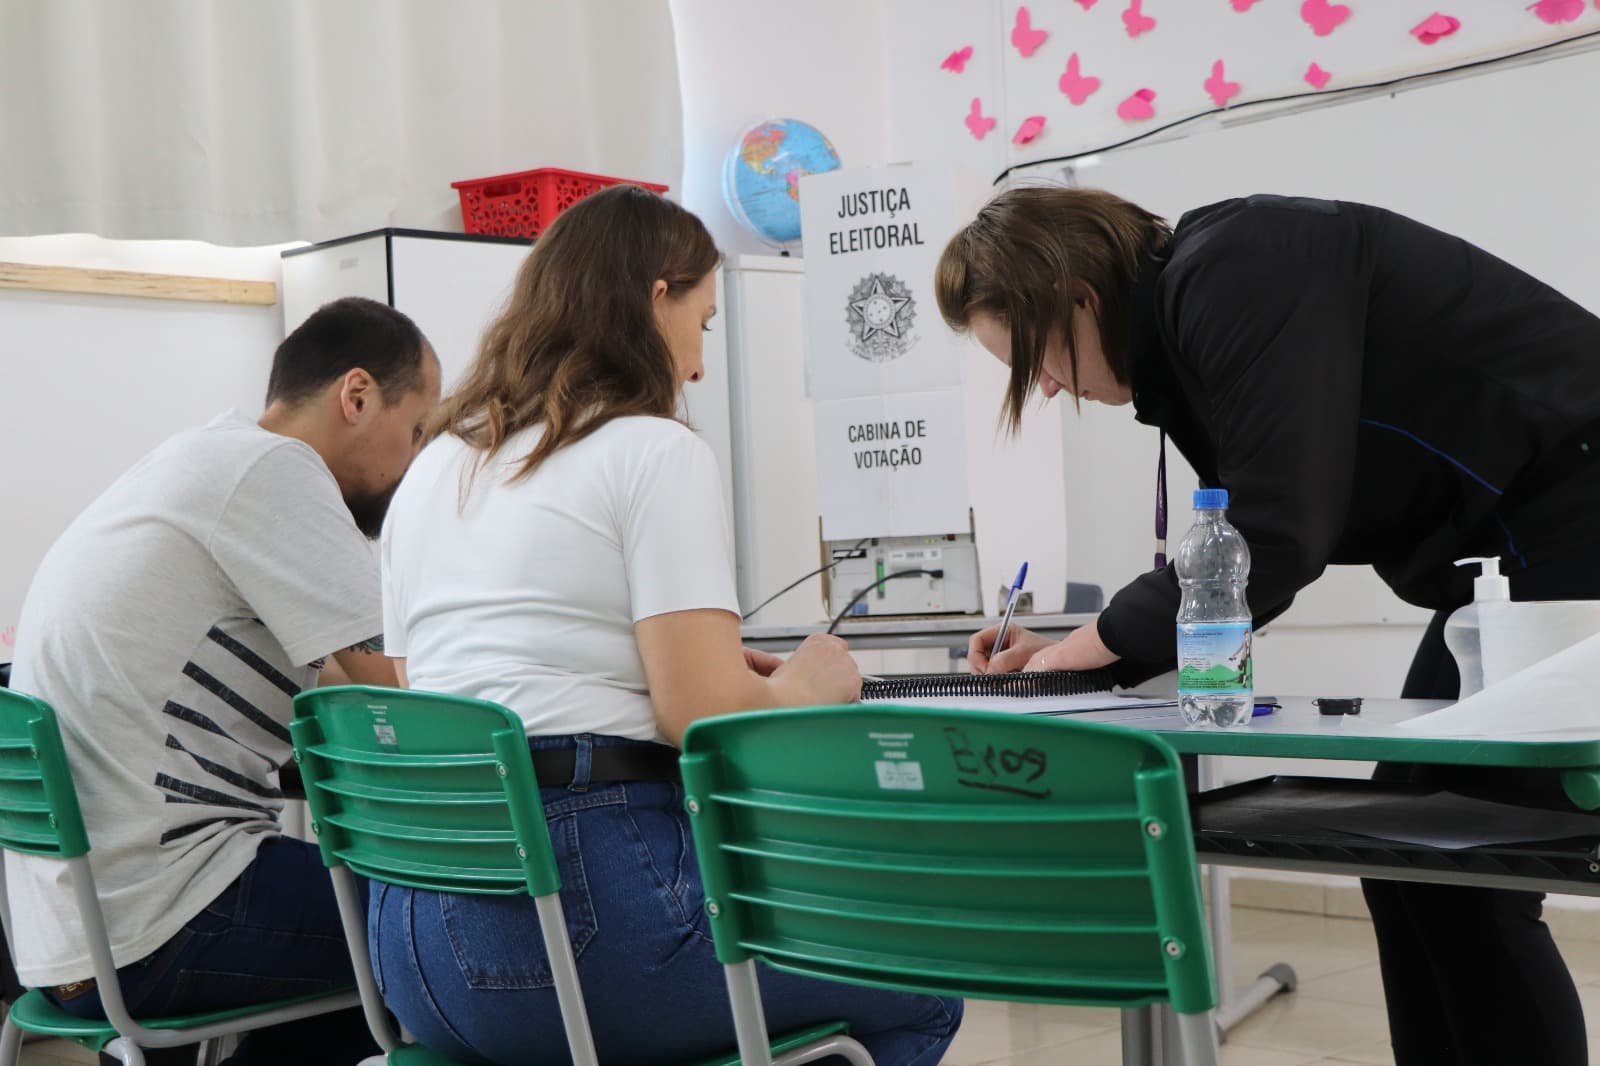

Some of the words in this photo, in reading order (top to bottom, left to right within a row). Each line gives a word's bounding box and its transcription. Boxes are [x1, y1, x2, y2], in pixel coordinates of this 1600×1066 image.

[838, 187, 911, 218] JUSTIÇA
[829, 222, 924, 255] ELEITORAL
[848, 422, 901, 443] CABINA
[904, 419, 926, 438] DE
[854, 444, 922, 472] VOTAÇÃO
